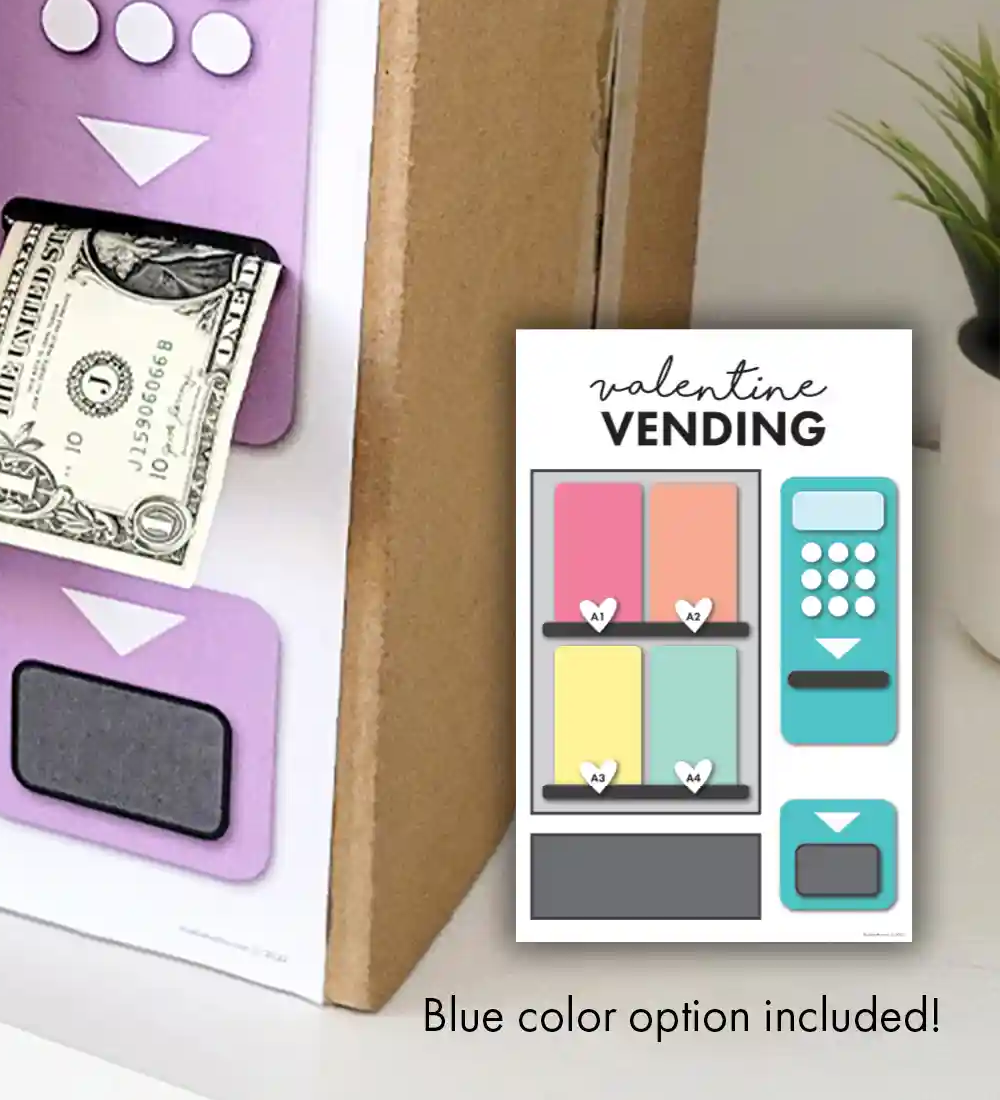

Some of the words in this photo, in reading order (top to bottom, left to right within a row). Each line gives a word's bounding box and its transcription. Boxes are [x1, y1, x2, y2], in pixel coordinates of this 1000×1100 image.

[7, 264, 56, 358] UNITED
[213, 291, 248, 366] ONE
[87, 374, 113, 395] J
[64, 431, 84, 455] 10
[148, 457, 169, 481] 10
